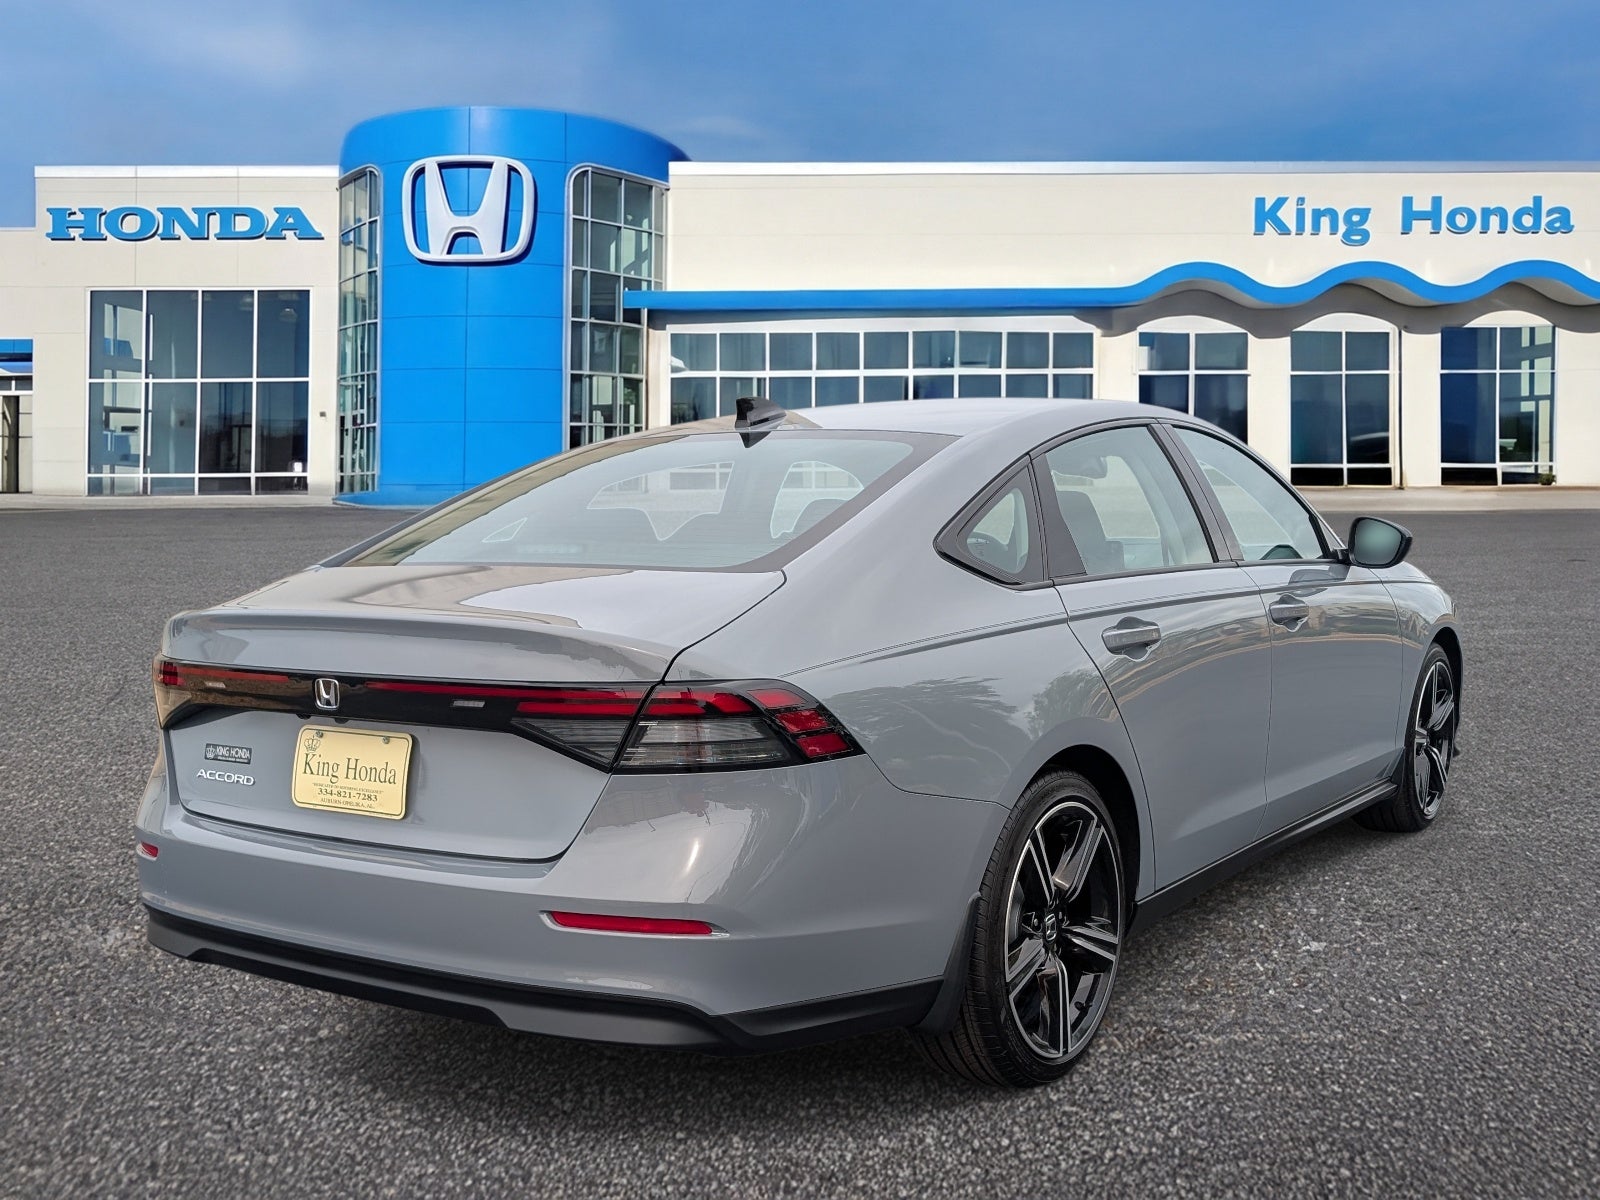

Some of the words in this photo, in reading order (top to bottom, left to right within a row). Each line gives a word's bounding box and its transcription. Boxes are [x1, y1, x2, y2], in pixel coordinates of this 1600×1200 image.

[45, 206, 325, 241] HONDA
[1253, 196, 1372, 247] King
[1400, 195, 1576, 235] Honda
[216, 745, 230, 757] KING
[230, 747, 250, 759] HONDA
[196, 768, 255, 786] ACCORD
[302, 752, 340, 784] King
[345, 757, 397, 785] Honda
[317, 787, 378, 802] 334-821-7283
